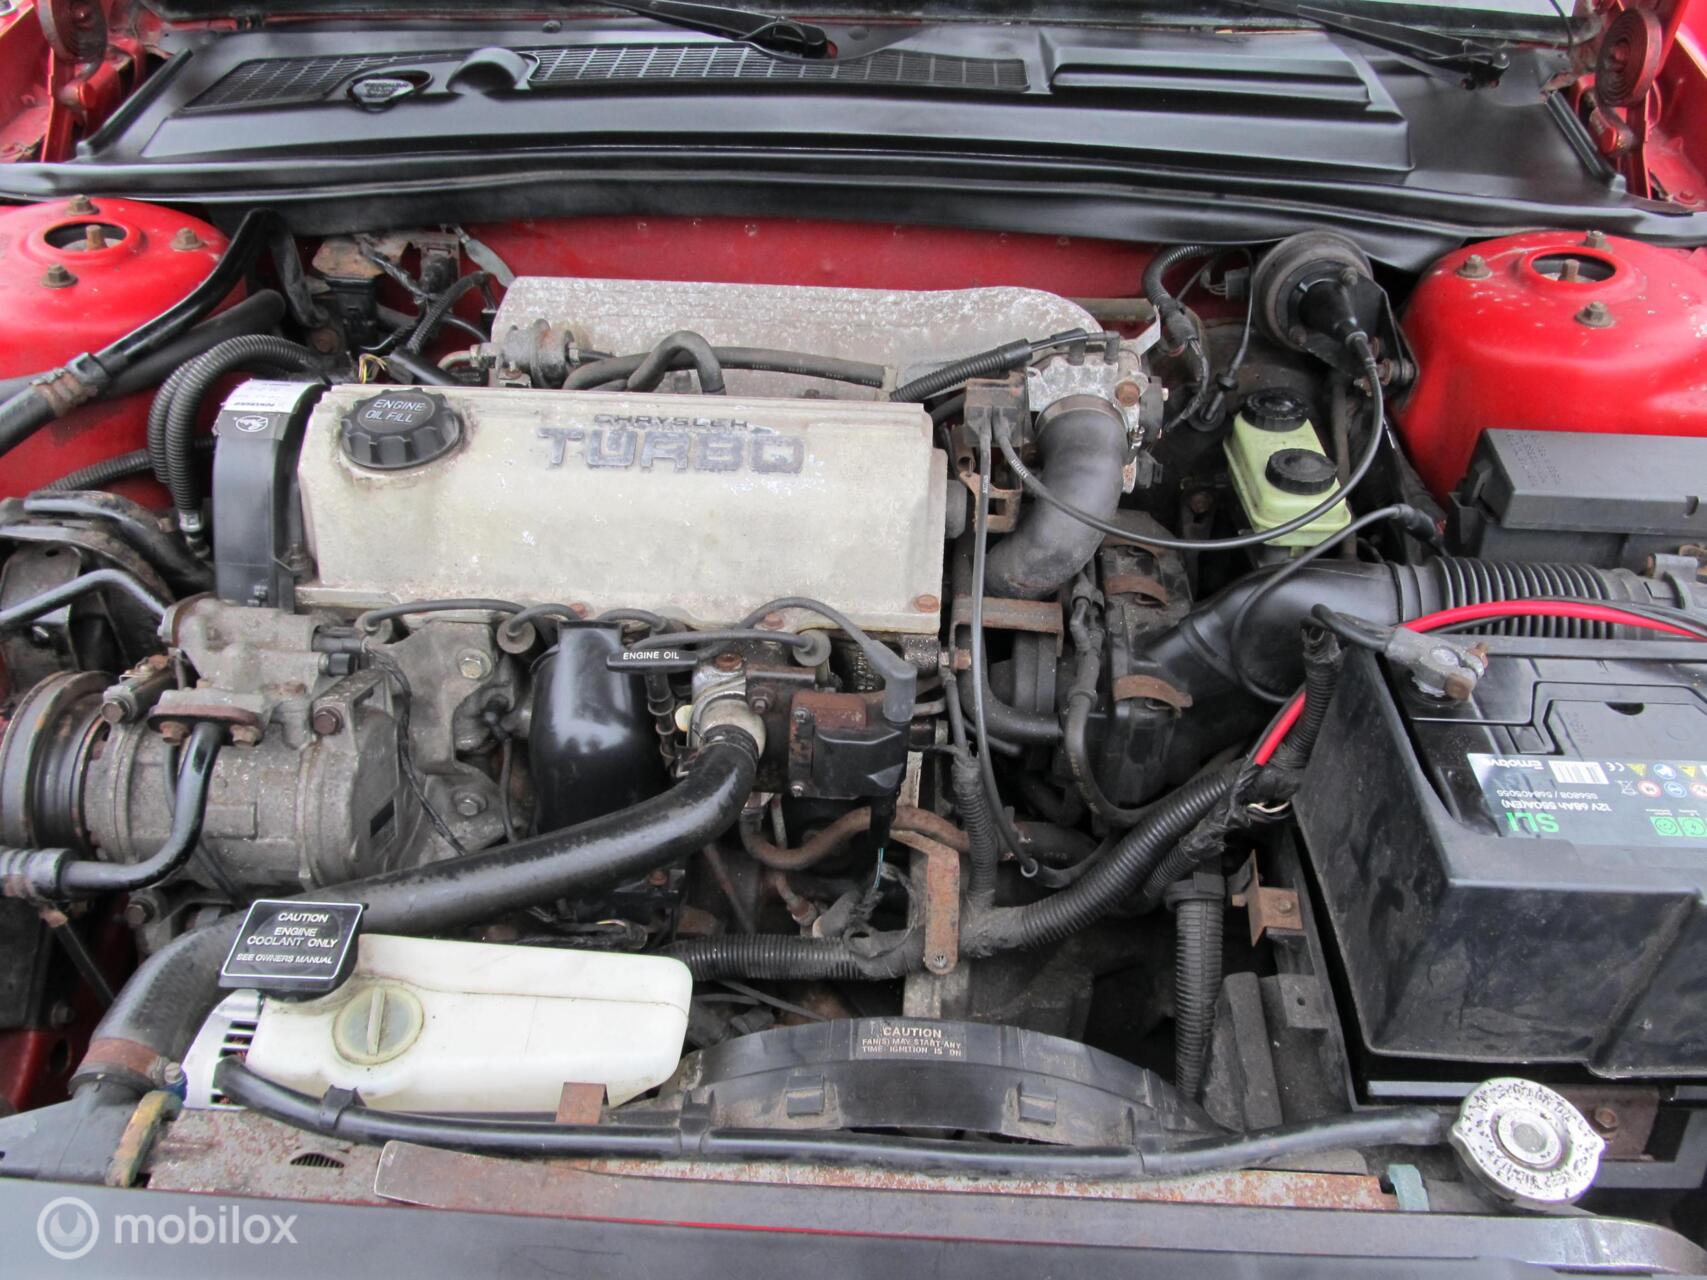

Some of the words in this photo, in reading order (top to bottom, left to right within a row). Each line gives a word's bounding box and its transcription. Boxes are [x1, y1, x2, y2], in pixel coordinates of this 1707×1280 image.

[373, 399, 425, 411] ENGINE
[365, 410, 382, 420] OIL
[385, 411, 413, 422] FILL
[537, 427, 804, 473] TURBO
[623, 651, 660, 660] ENGINE
[663, 651, 679, 659] OIL
[1501, 799, 1556, 811] 550A(EN)
[1557, 801, 1589, 811] 68Ah
[1591, 802, 1612, 812] 12V
[1505, 812, 1560, 833] SLI
[278, 912, 329, 923] CAUTION
[274, 926, 318, 937] ENGINE
[247, 936, 304, 947] COOLANT
[307, 938, 338, 948] ONLY
[236, 953, 254, 961] SEE
[255, 953, 294, 963] OWNERS
[295, 955, 333, 964] MANUAL
[883, 1027, 942, 1038] CAUTION
[862, 1038, 890, 1046] FAN(S)
[892, 1038, 911, 1046] MAY
[913, 1039, 940, 1047] START
[943, 1041, 961, 1049] ANY
[890, 1046, 928, 1054] IGNITION
[934, 1047, 943, 1055] IS
